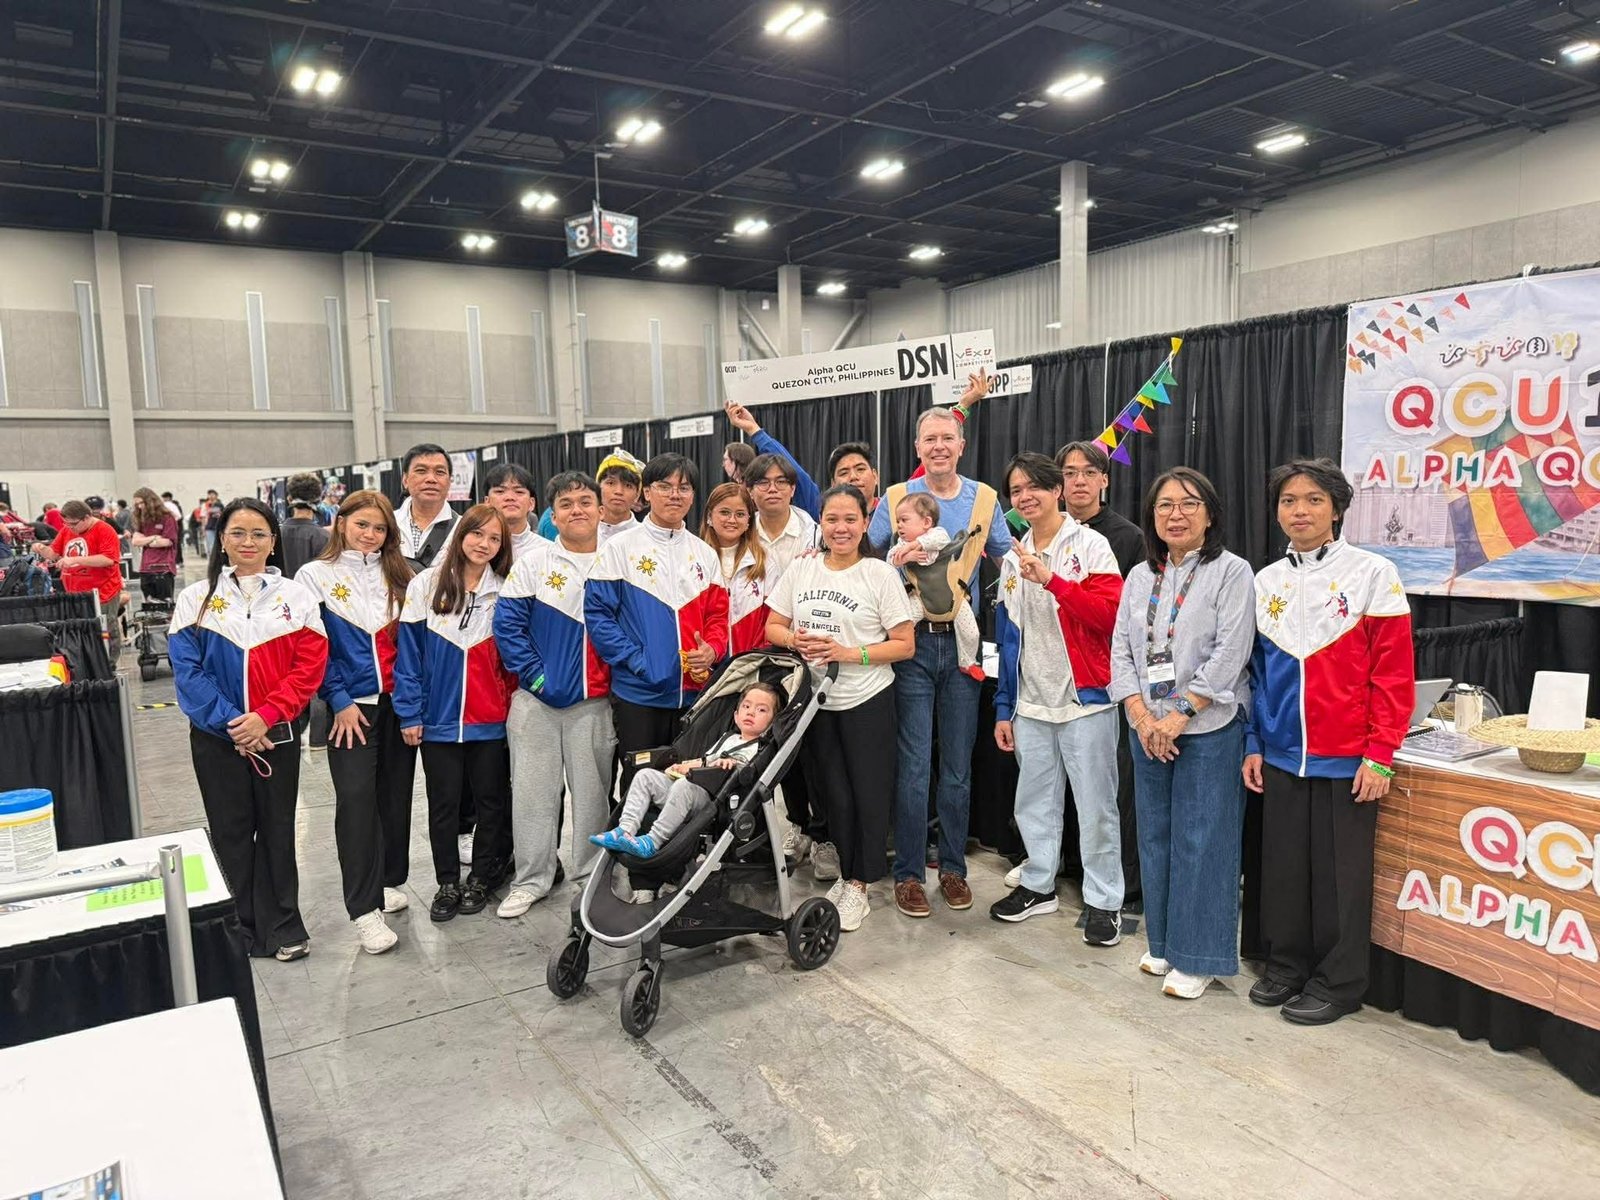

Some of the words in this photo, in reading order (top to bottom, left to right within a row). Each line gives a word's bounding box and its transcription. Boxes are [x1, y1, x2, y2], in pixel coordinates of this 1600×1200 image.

[575, 225, 590, 249] 8
[611, 225, 628, 249] 8
[807, 365, 833, 377] Alpha
[835, 363, 856, 373] QCU
[897, 342, 949, 381] DSN
[771, 378, 811, 390] QUEZON
[813, 375, 836, 385] CITY,
[838, 367, 895, 381] PHILIPPINES
[1368, 453, 1515, 484] ALPHA
[798, 589, 859, 612] CALIFORNIA
[799, 620, 810, 629] LOS
[811, 622, 841, 633] ANGELES
[1407, 879, 1585, 950] ALPHA
